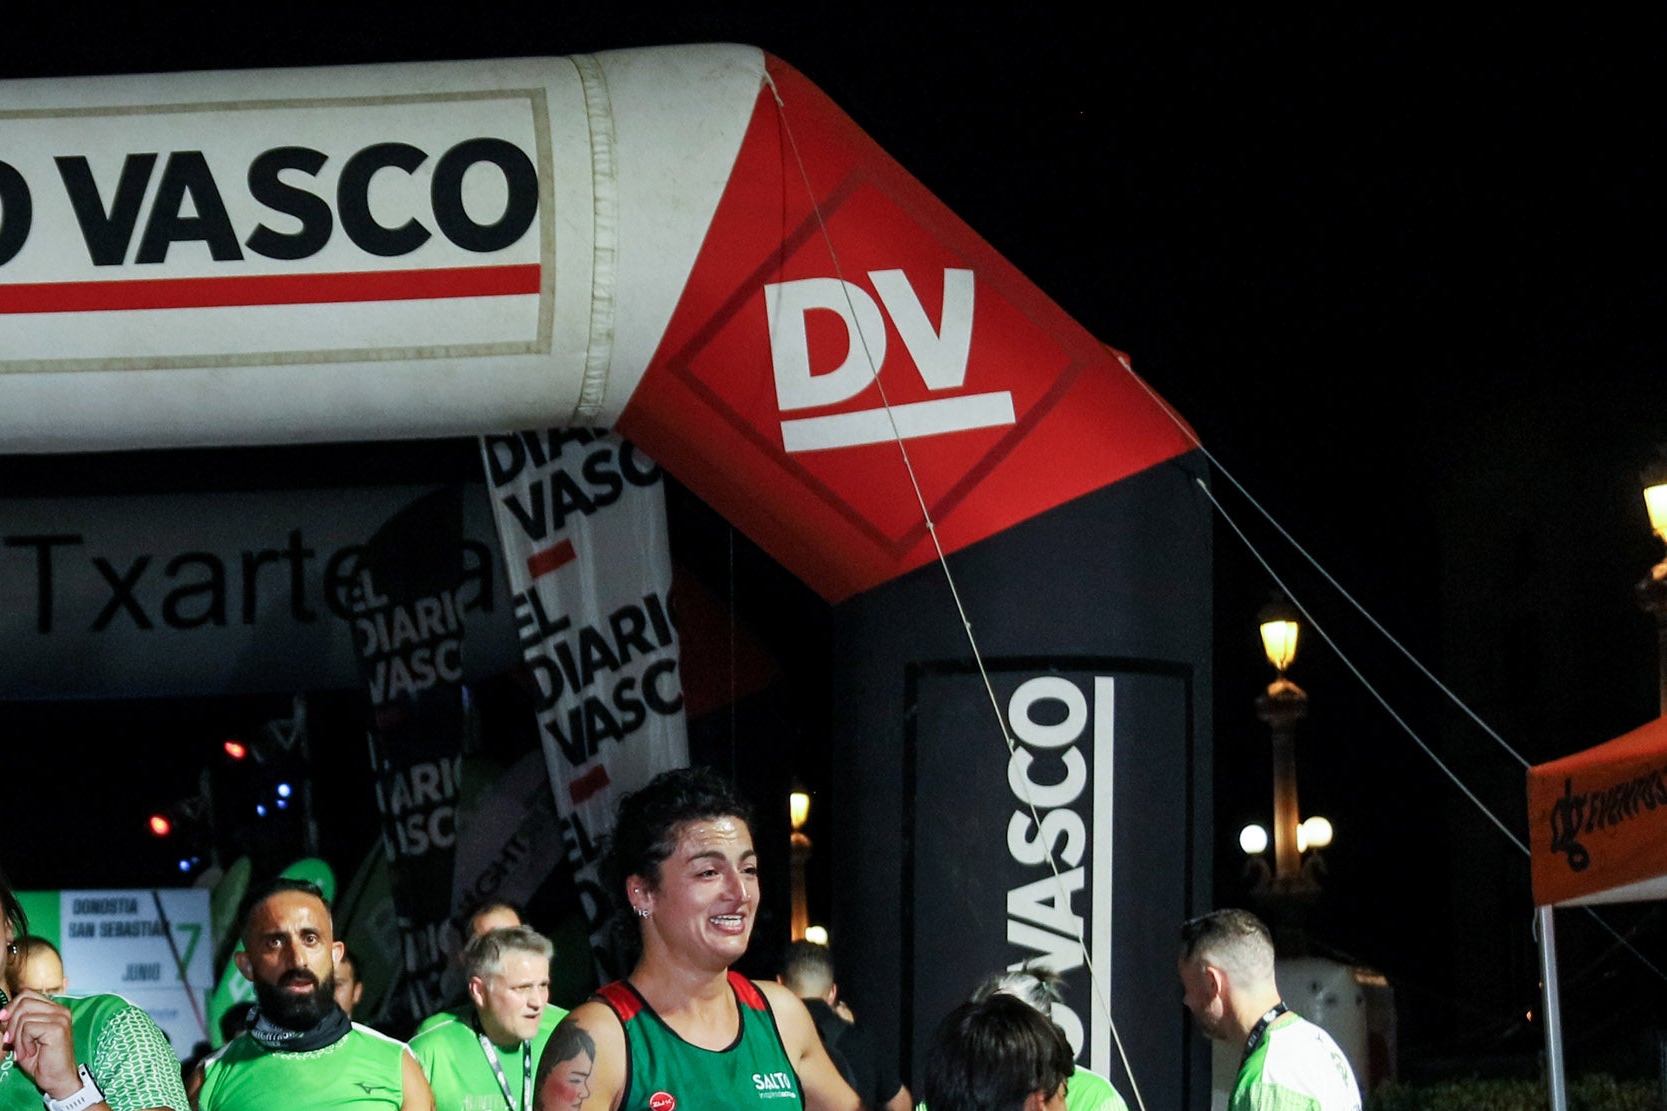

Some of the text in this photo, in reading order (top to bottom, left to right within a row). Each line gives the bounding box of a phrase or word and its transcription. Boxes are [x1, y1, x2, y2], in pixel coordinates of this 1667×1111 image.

[53, 137, 539, 266] VASCO
[764, 267, 975, 412] DV
[354, 589, 465, 658] DIARI
[530, 593, 680, 713] DIARI
[1006, 676, 1087, 974] VASCO
